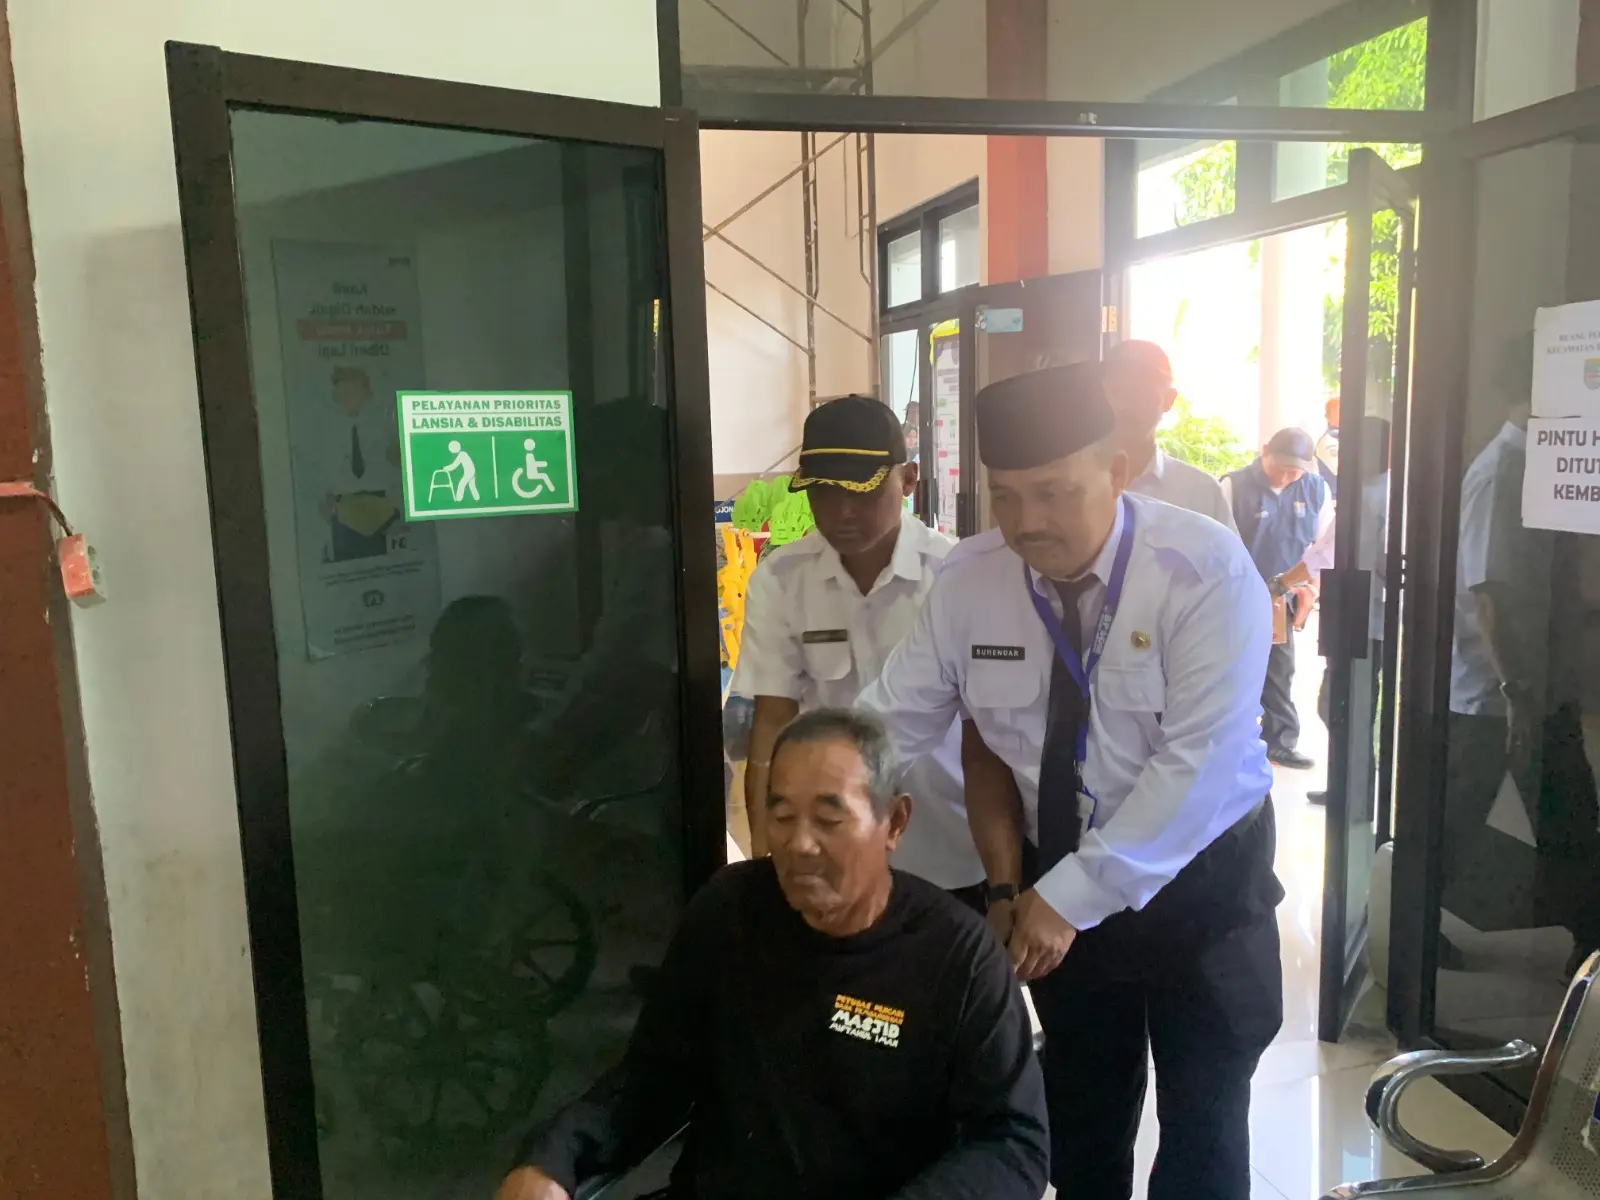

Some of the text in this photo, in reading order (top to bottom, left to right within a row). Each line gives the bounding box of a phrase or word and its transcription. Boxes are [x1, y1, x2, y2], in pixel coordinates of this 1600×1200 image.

[412, 400, 561, 410] PELAYANAN PRIORITAS
[412, 416, 561, 428] LANSIA & DISABILITAS
[1537, 430, 1587, 446] PINTU
[1554, 484, 1600, 502] KEMB
